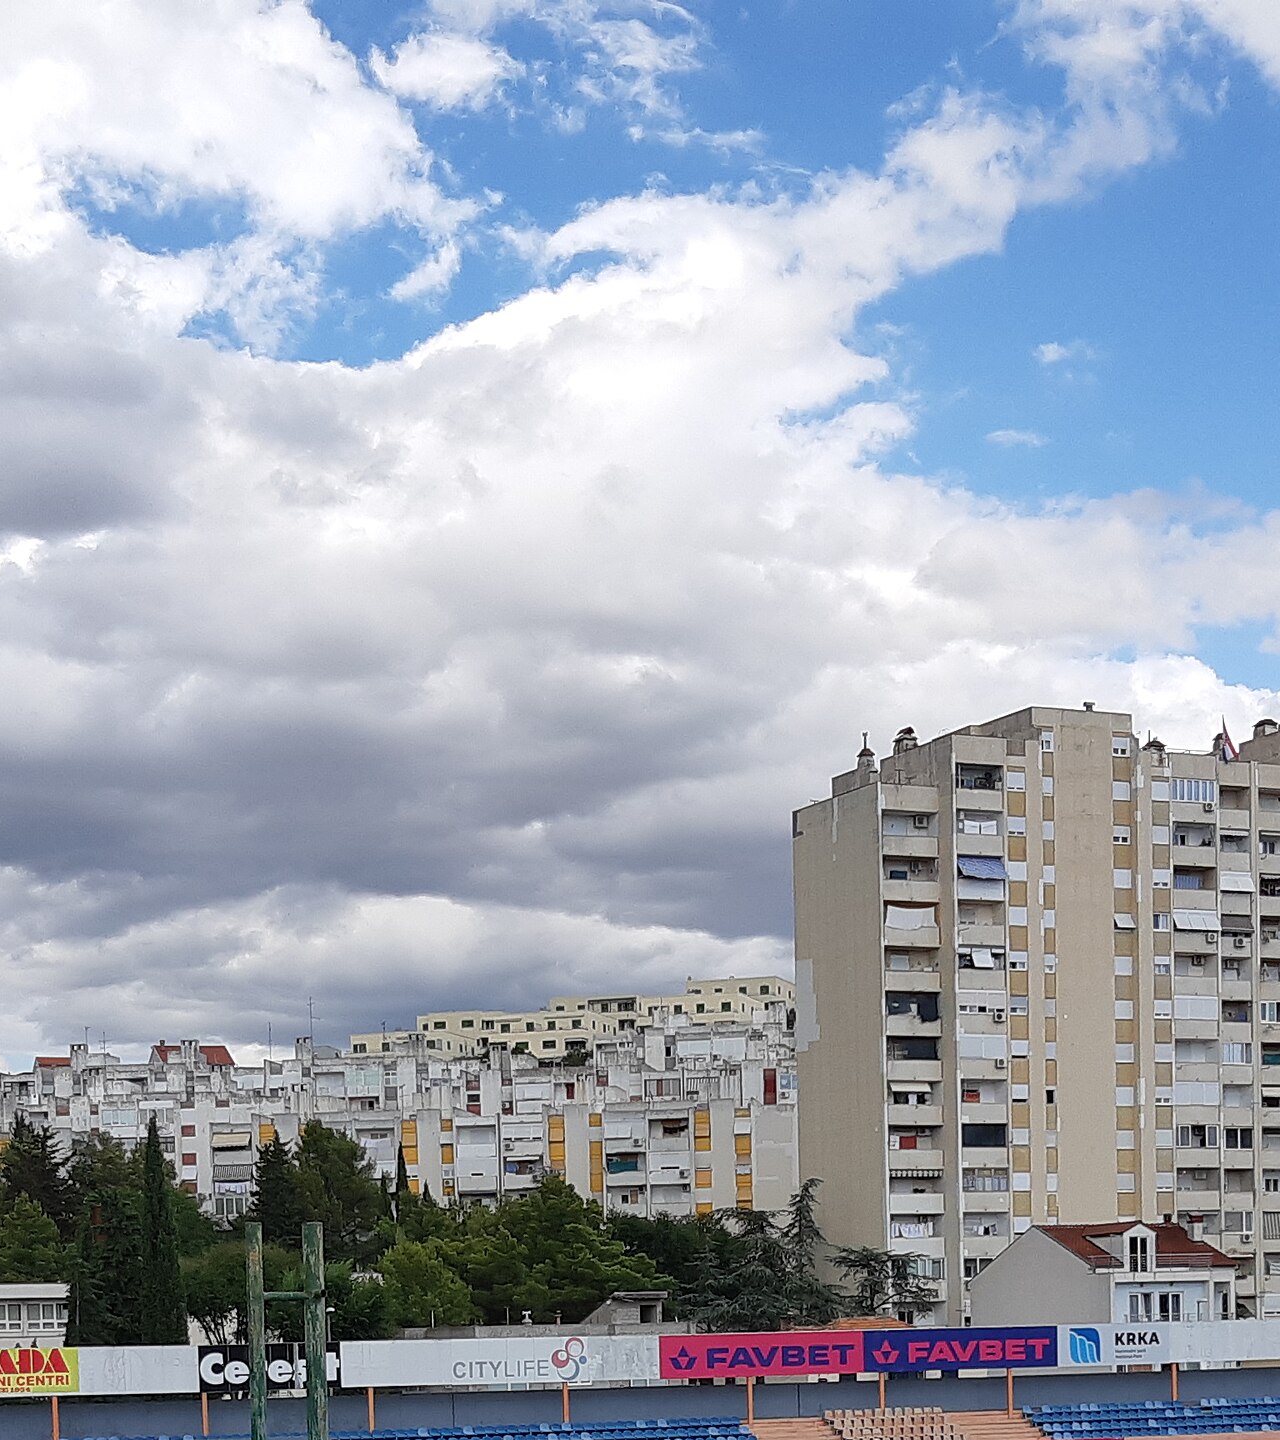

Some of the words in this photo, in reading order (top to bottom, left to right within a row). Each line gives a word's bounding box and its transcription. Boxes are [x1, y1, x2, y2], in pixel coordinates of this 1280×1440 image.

[1114, 1332, 1160, 1346] KRKA
[706, 1344, 854, 1369] FAVBET
[908, 1338, 1050, 1364] FAVBET
[453, 1359, 549, 1379] CITYLIFE
[16, 1375, 69, 1386] CENTRI
